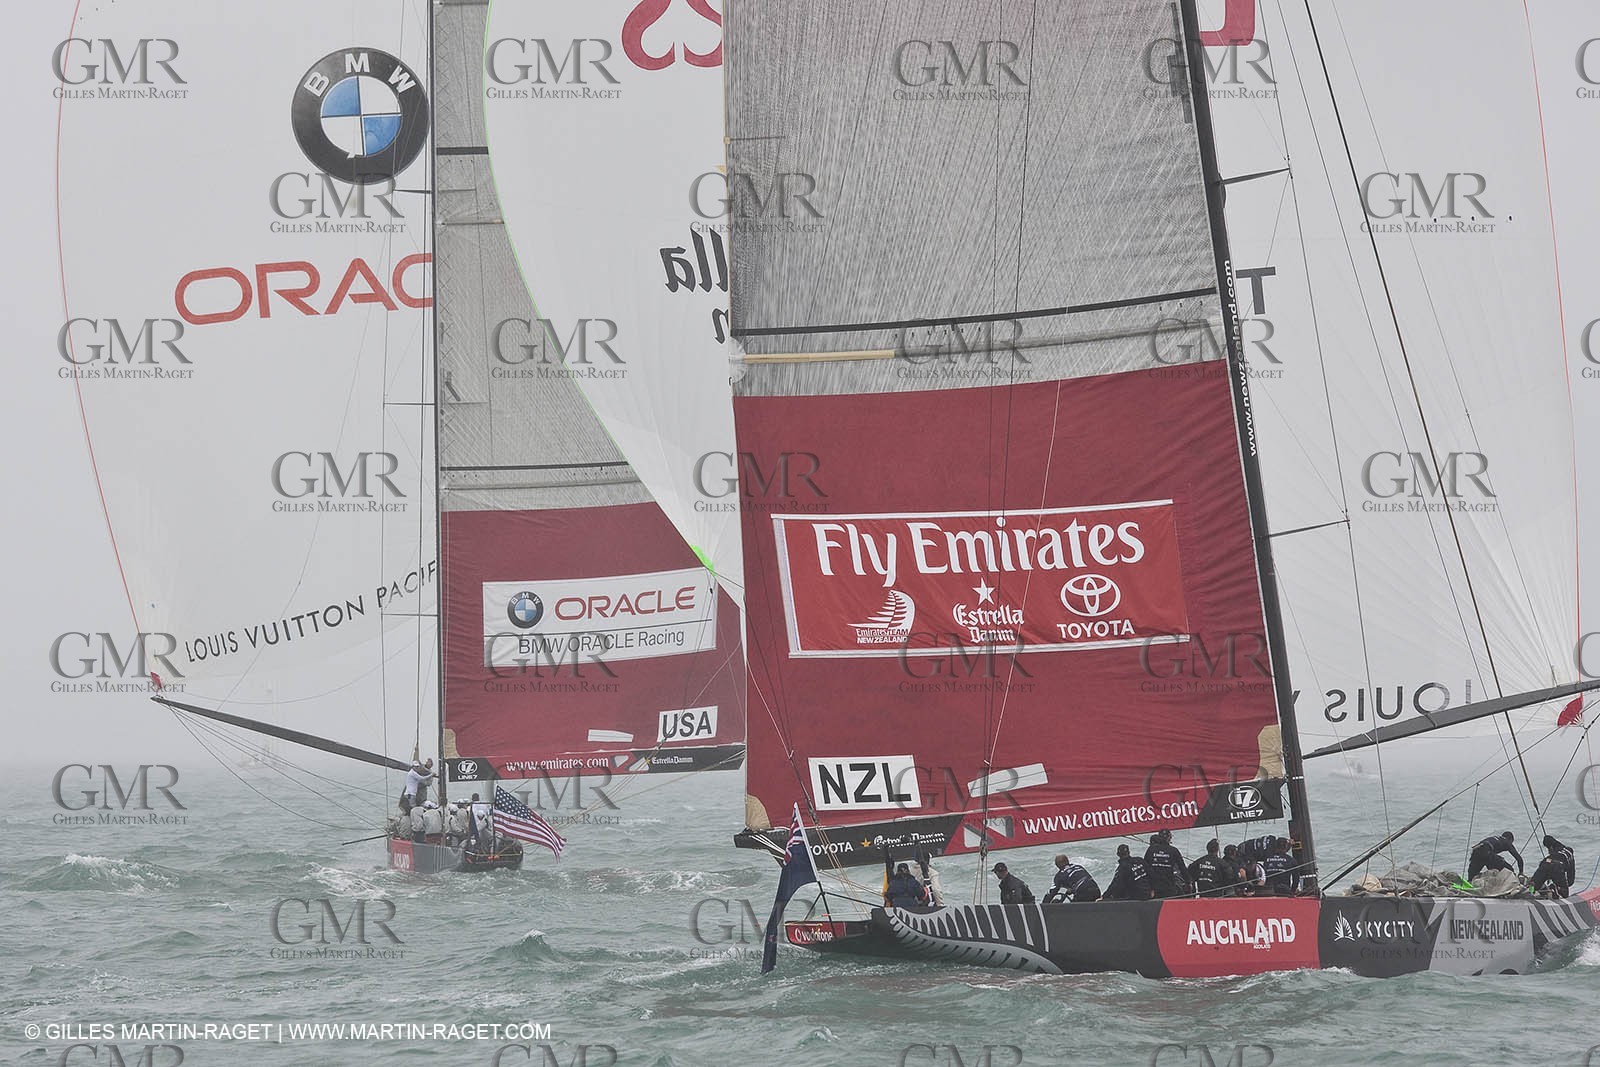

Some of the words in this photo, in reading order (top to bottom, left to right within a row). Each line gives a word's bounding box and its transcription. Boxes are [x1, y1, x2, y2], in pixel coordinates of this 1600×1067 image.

[304, 52, 416, 97] BMW
[811, 522, 897, 588] Fly
[906, 516, 1145, 574] Emirates
[554, 586, 696, 621] ORACLE
[952, 603, 1025, 627] Estrella
[185, 631, 239, 663] LOUIS
[244, 595, 366, 649] VUITTON
[518, 635, 564, 654] BMW
[567, 632, 635, 651] ORACLE
[638, 628, 685, 646] Racing
[967, 626, 1016, 644] Damm
[1056, 620, 1135, 640] TOYOTA
[662, 710, 713, 739] USA
[505, 756, 610, 772] www.emirates.com
[817, 761, 913, 804] NZL
[1022, 800, 1200, 834] www.emirates.com
[1187, 918, 1296, 945] AUCKLAND
[1356, 918, 1415, 940] SKYCITY
[1450, 918, 1476, 940] NEW
[1477, 918, 1524, 940] ZEALAND
